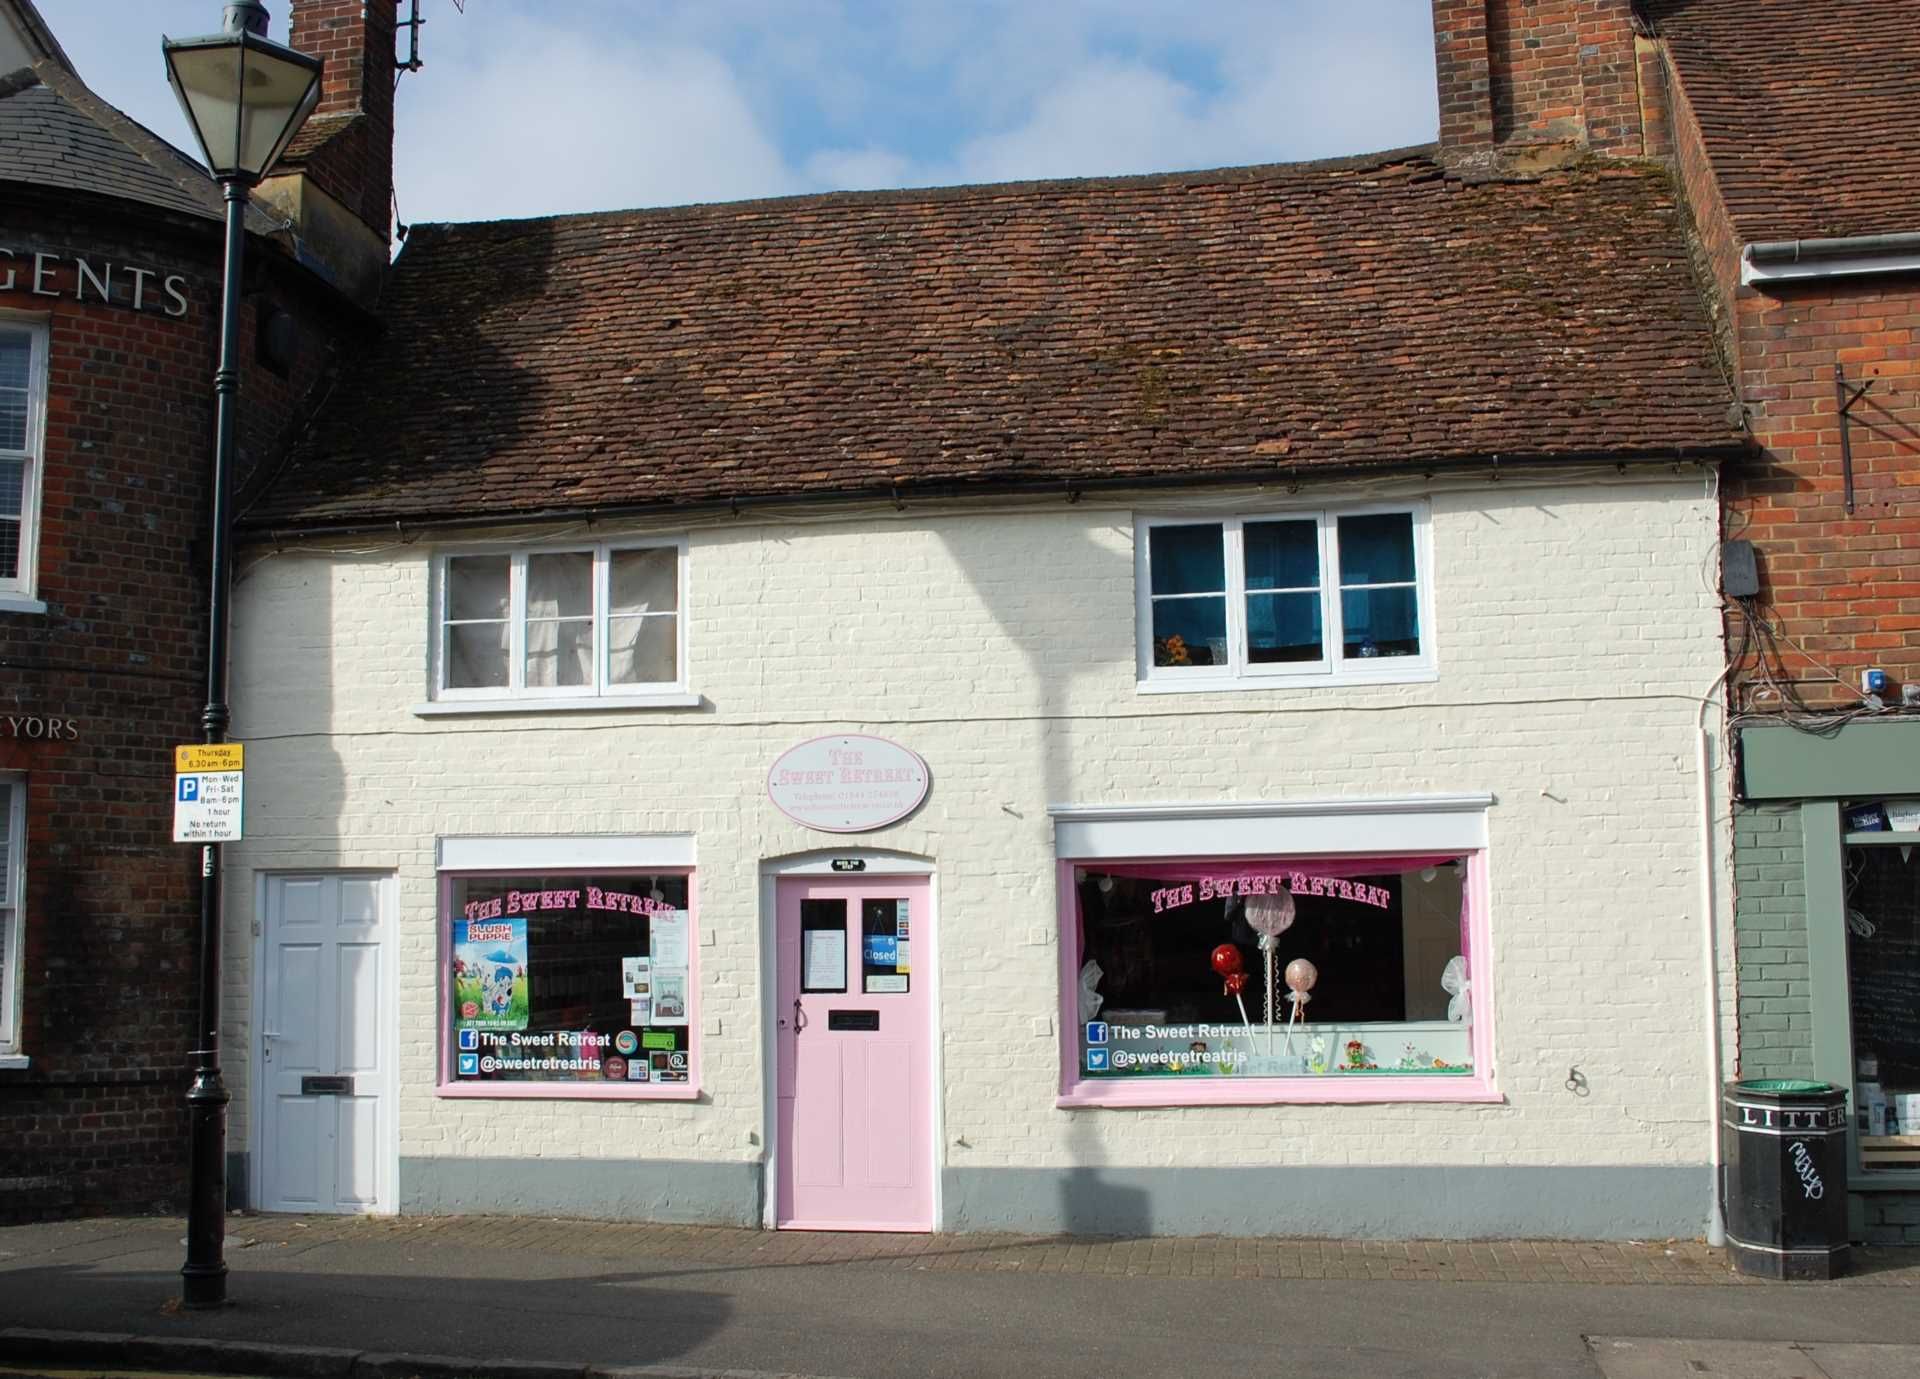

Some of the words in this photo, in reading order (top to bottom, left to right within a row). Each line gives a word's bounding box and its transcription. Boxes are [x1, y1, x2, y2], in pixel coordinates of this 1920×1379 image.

[0, 716, 78, 740] YORS
[198, 748, 231, 757] Thursday
[828, 749, 864, 766] THE
[779, 769, 834, 785] SWEET
[840, 767, 914, 784] RETREAT
[183, 780, 196, 800] P
[213, 808, 231, 816] hour
[189, 820, 200, 828] No
[202, 820, 227, 828] return
[184, 830, 207, 838] within
[214, 829, 232, 837] hour
[1151, 884, 1193, 913] THE
[1199, 875, 1281, 900] SWEET
[1289, 871, 1390, 909] RETREAT
[465, 897, 502, 923] THE
[507, 889, 580, 914] SWEET
[469, 925, 512, 933] SLUSH
[864, 949, 896, 961] Closed
[480, 1032, 510, 1046] The
[511, 1032, 555, 1046] Sweet
[558, 1033, 611, 1046] Retreat
[1111, 1025, 1141, 1039] The
[1145, 1025, 1194, 1038] Sweet
[1198, 1024, 1255, 1038] Retreat
[480, 1056, 601, 1072] @sweetretreatris
[1111, 1049, 1248, 1067] @sweetretreatris
[1743, 1107, 1845, 1129] LITTER
